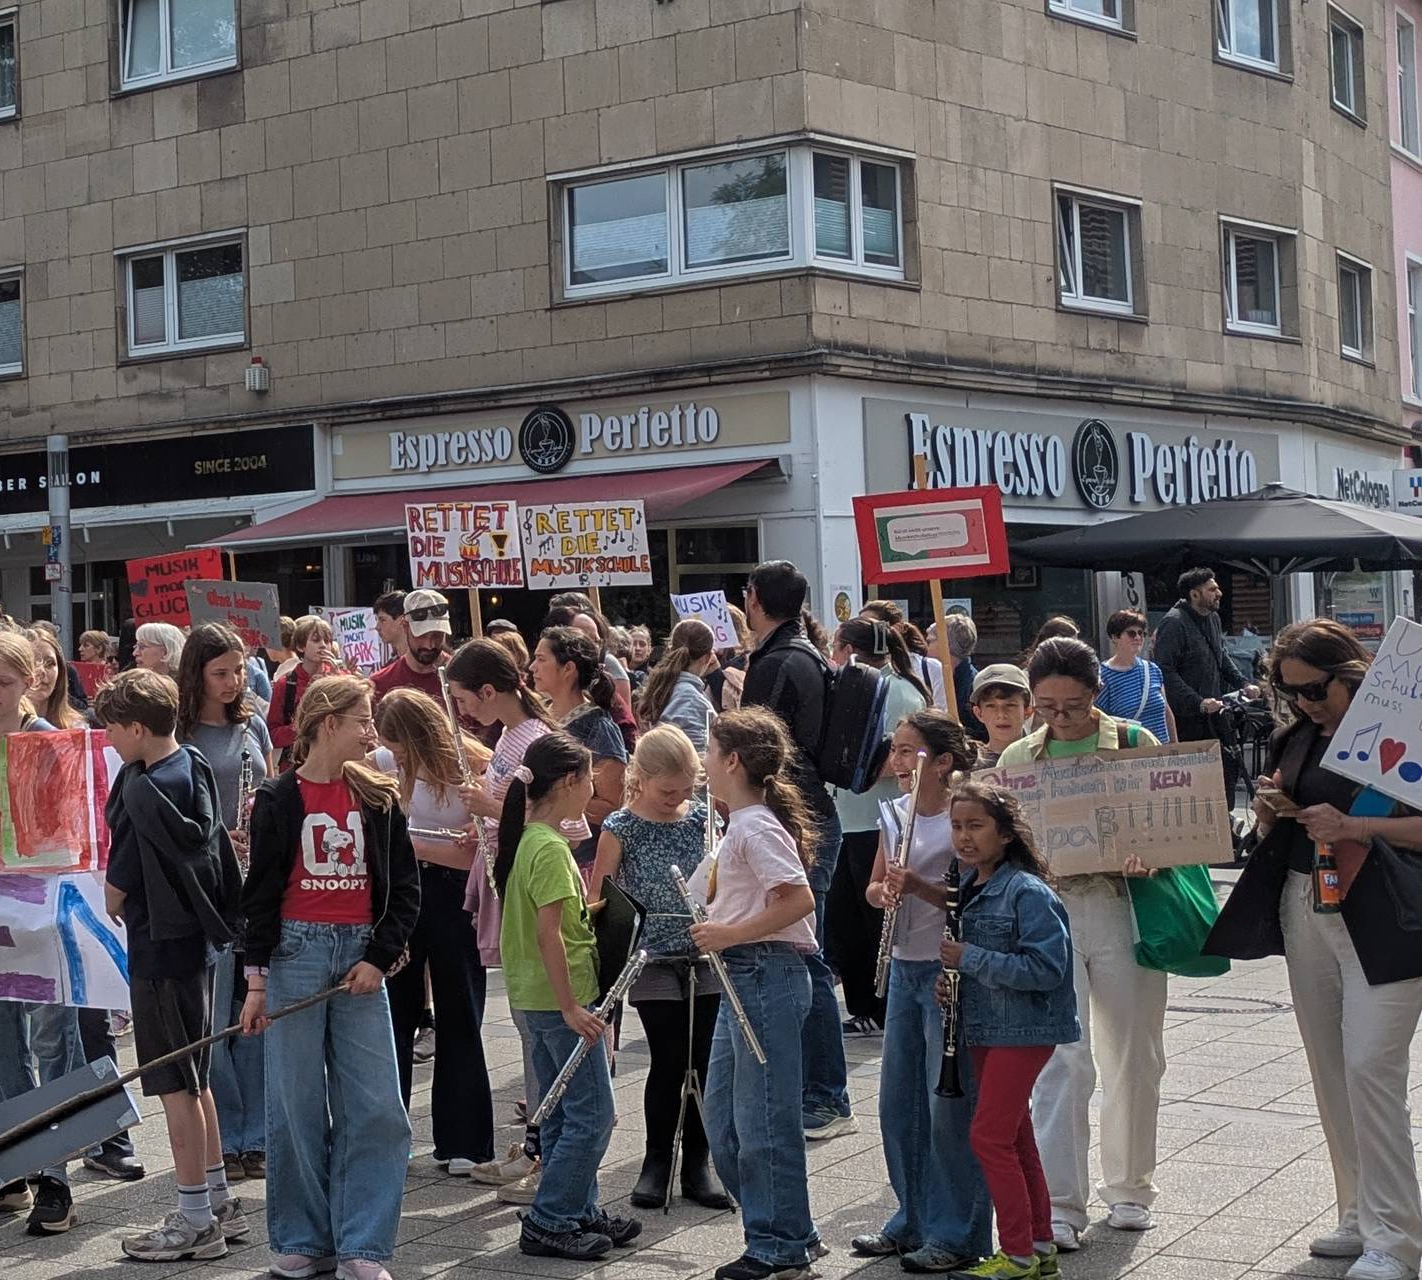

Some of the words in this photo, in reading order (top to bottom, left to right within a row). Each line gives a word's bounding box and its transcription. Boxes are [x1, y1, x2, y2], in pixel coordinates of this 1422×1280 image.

[389, 426, 512, 473] Espresso
[580, 402, 719, 453] Perfetto
[194, 460, 231, 475] SINCE
[234, 454, 267, 471] 2004
[907, 413, 1067, 498] Espresso
[1128, 432, 1257, 504] Perfetto
[1336, 467, 1390, 509] NetCologne
[407, 503, 510, 533] RETTET
[535, 507, 636, 535] RETTET
[411, 535, 446, 558] DIE
[561, 532, 602, 556] DIE
[145, 557, 200, 578] MUSIK
[530, 554, 651, 577] MUSIKSCHULE
[135, 593, 189, 618] GLÜC
[339, 613, 366, 632] MUSIK
[344, 631, 365, 643] MACHT
[1364, 692, 1403, 714] muss
[1149, 769, 1192, 792] KEIN
[300, 878, 367, 891] SNOOPY
